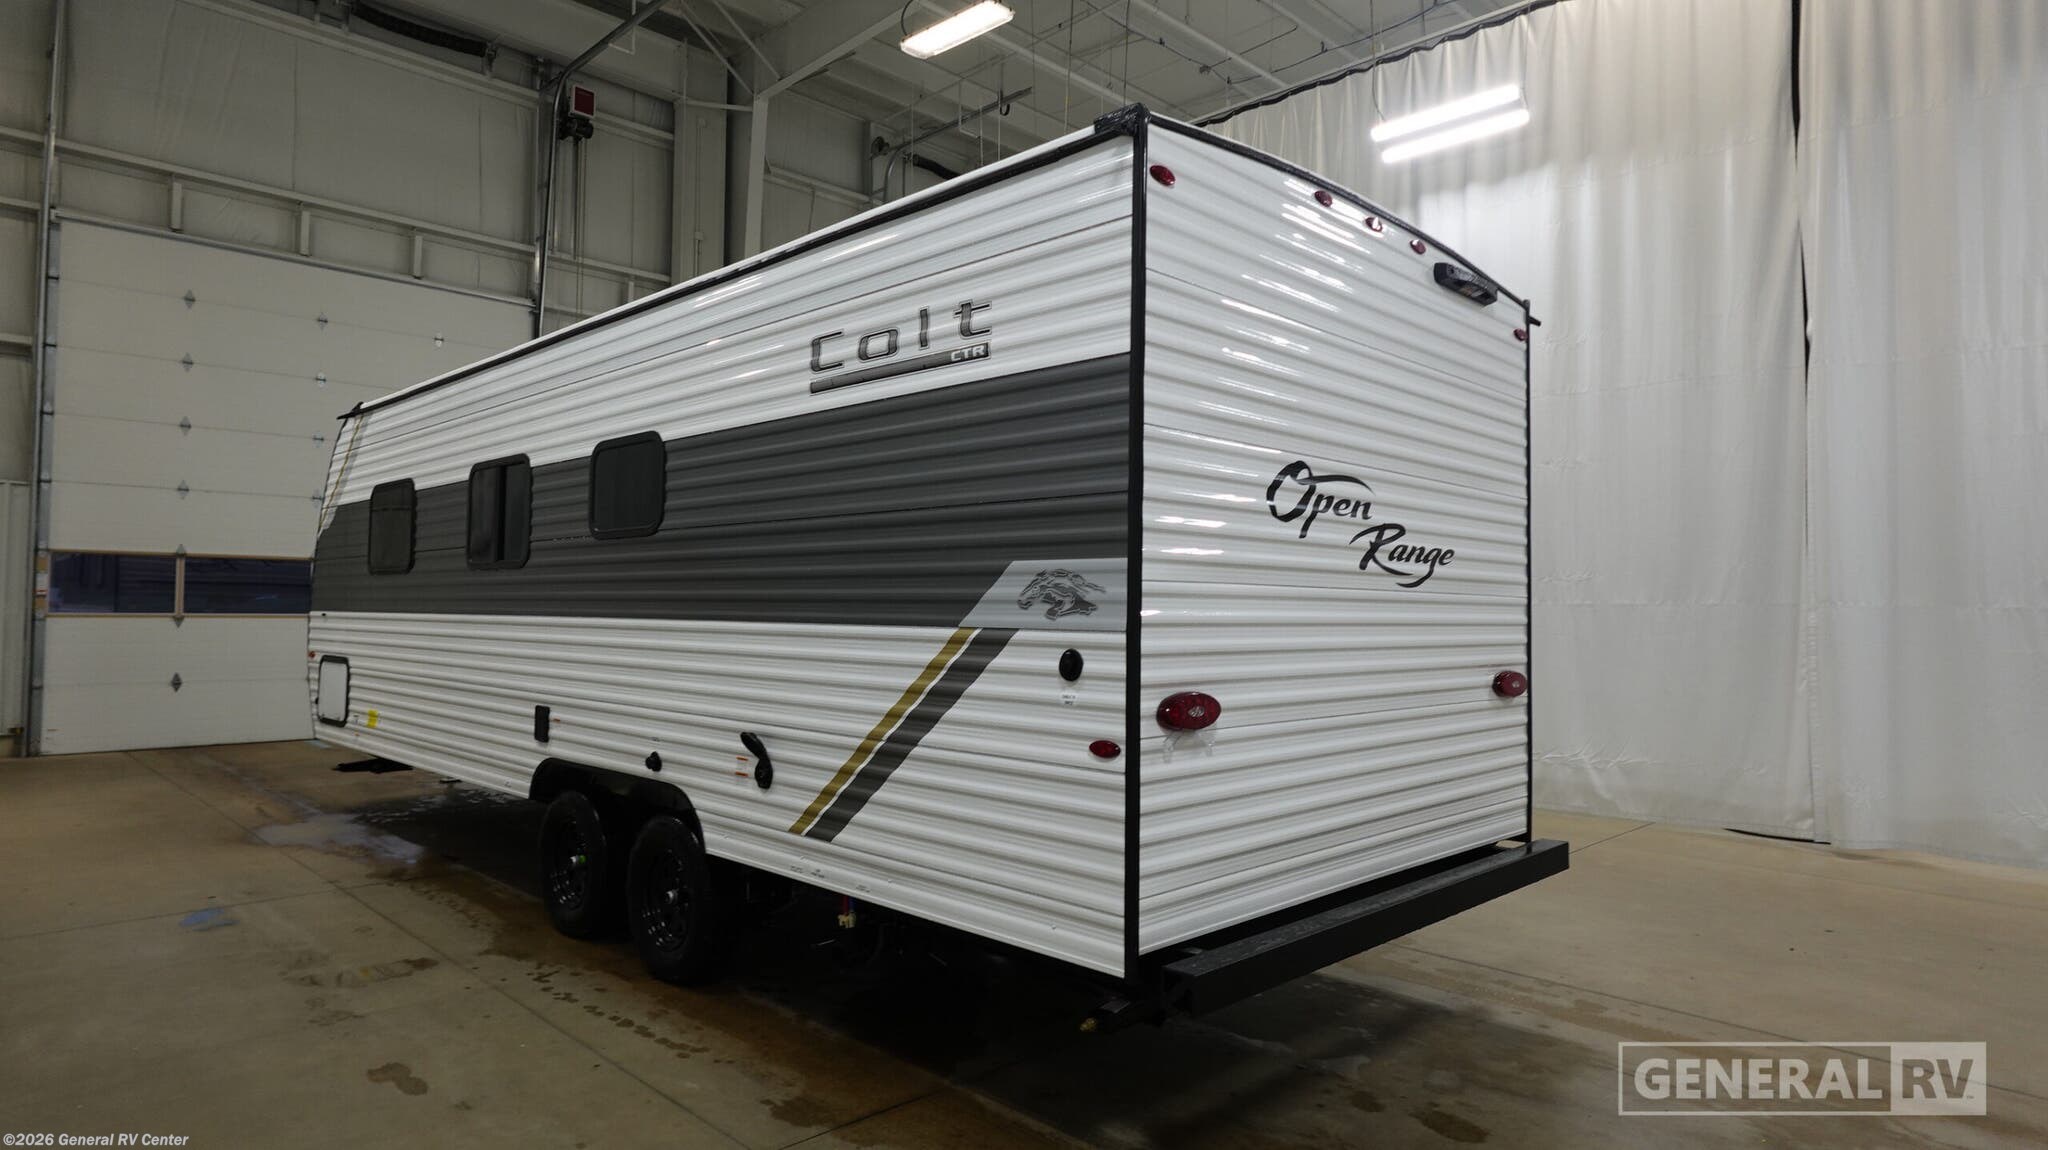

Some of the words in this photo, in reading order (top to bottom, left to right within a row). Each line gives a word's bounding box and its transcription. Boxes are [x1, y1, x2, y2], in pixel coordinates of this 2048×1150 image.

[811, 302, 991, 371] Colt
[951, 345, 985, 362] CTR
[1266, 460, 1376, 539] Open
[1349, 523, 1456, 588] Range
